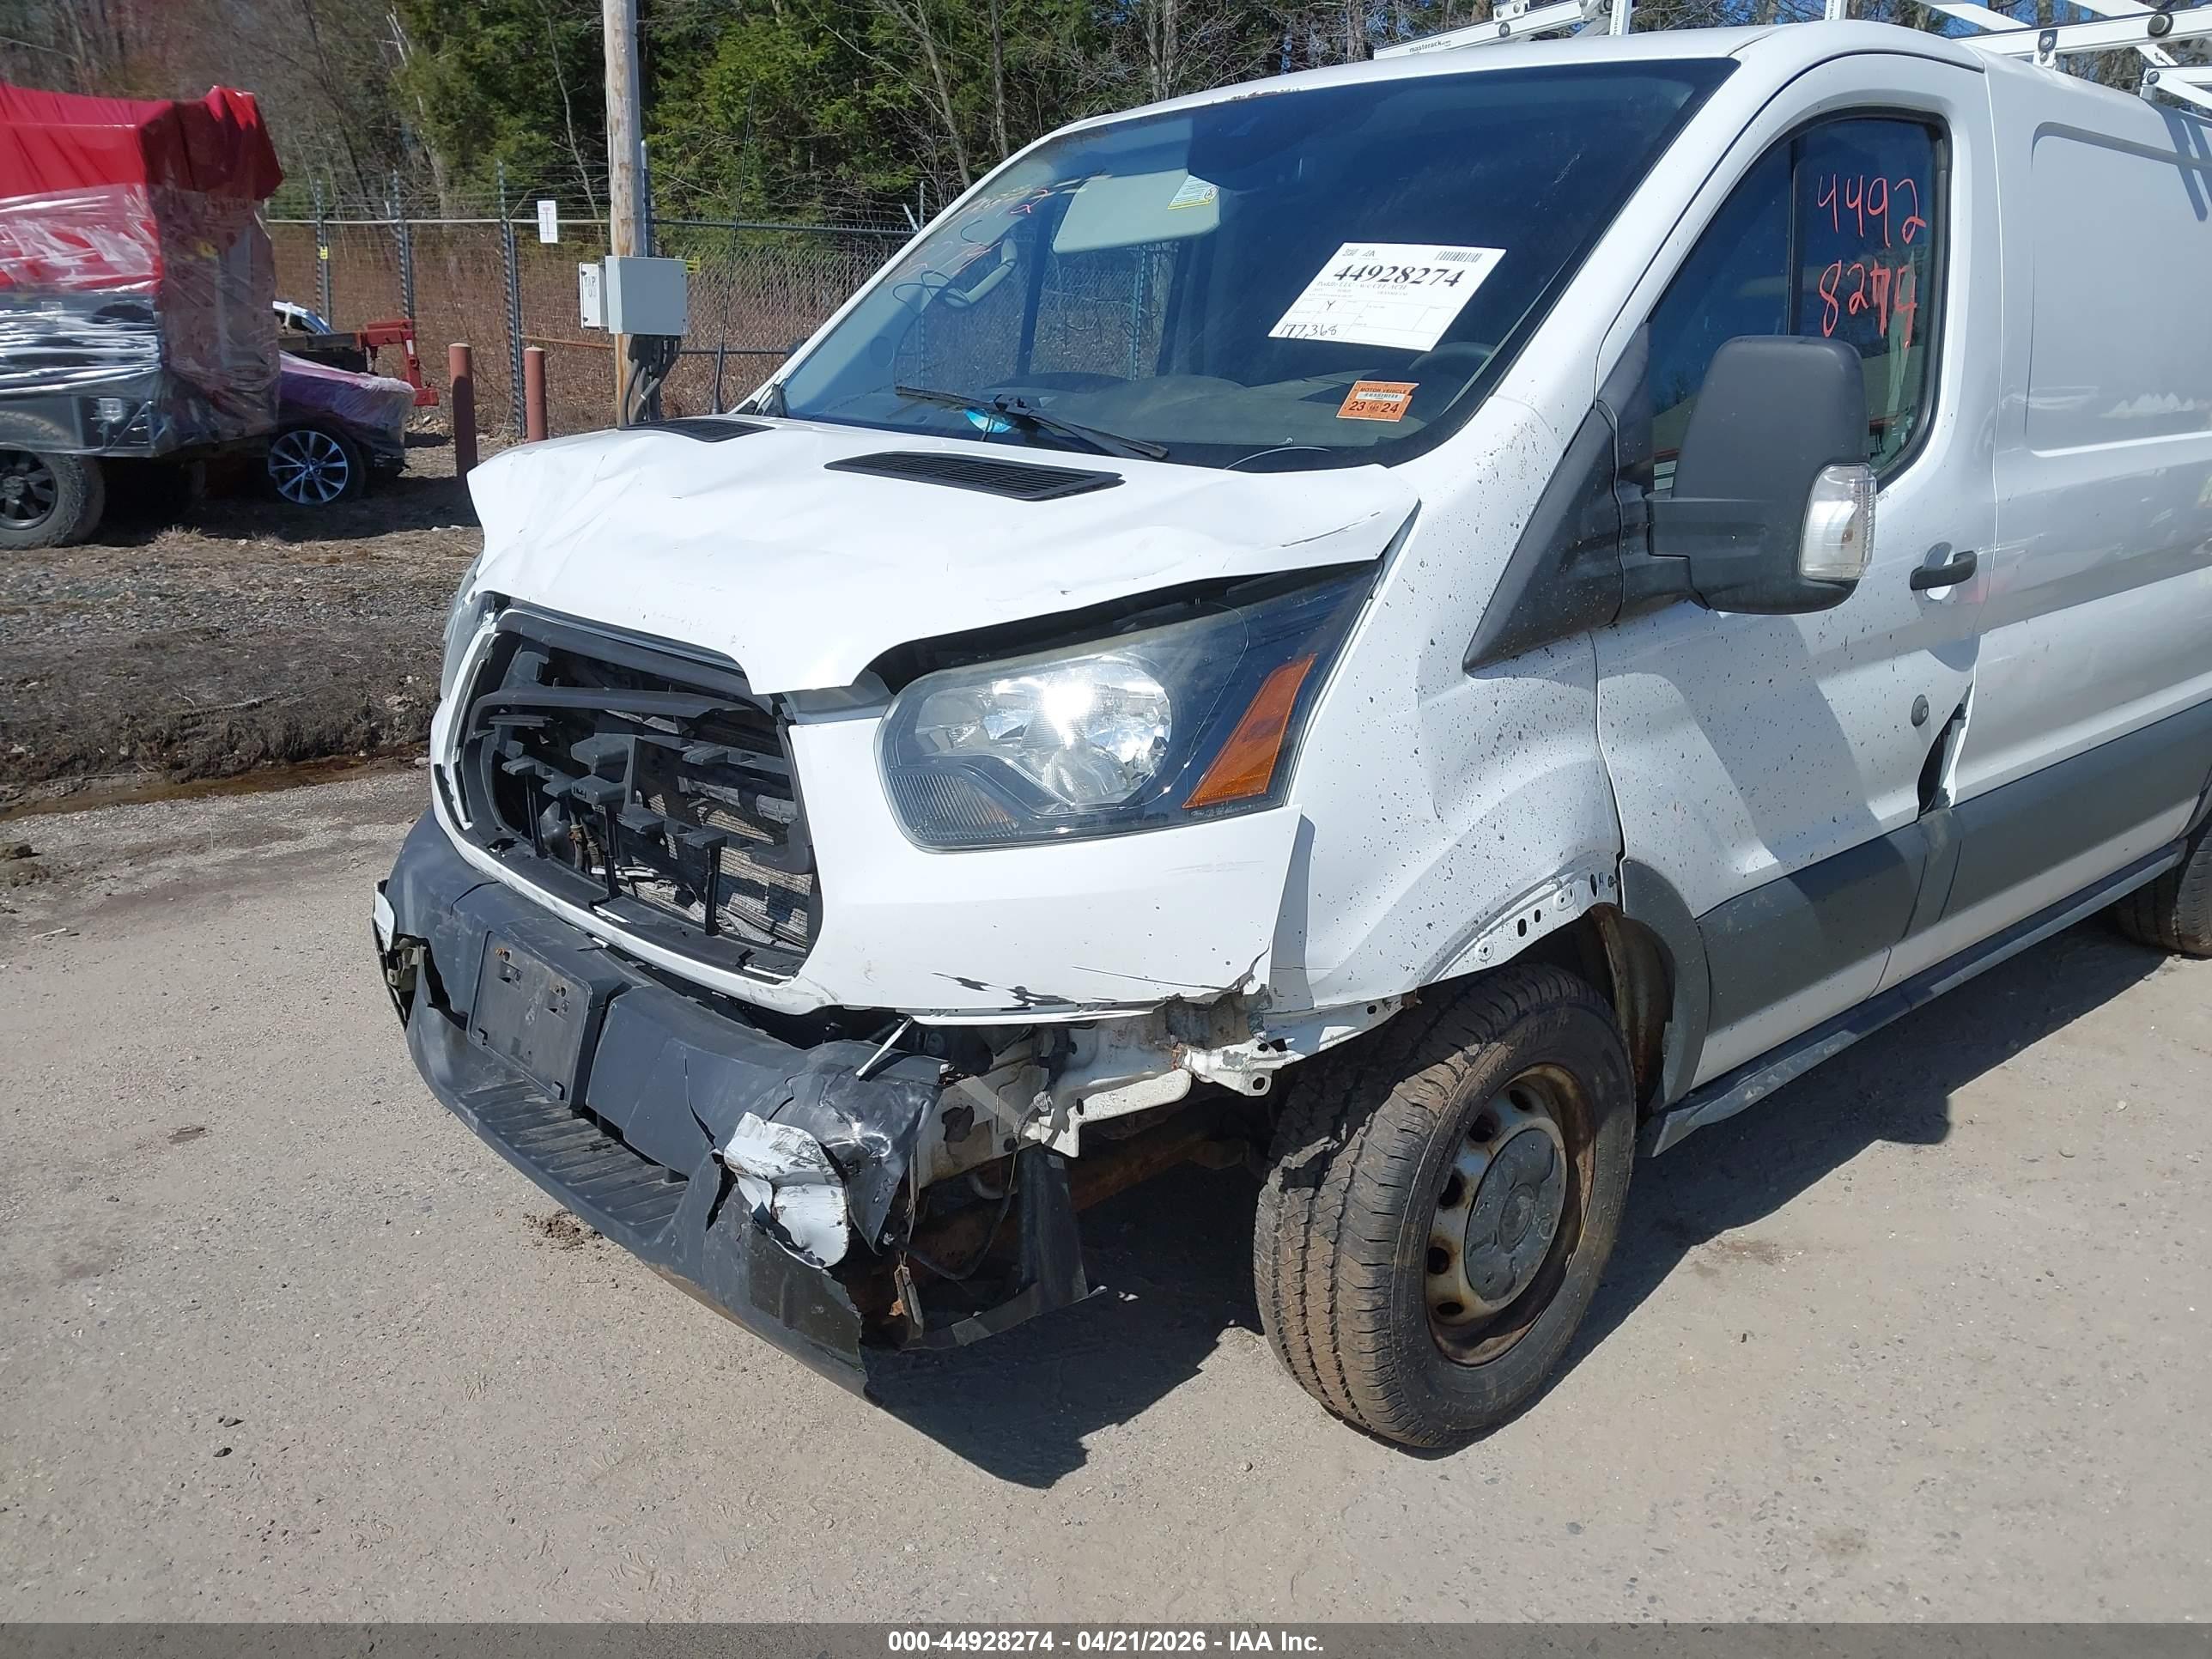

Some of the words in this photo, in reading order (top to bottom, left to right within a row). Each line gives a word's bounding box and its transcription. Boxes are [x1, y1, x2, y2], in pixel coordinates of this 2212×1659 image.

[1817, 173, 1926, 247] 4492
[1334, 264, 1466, 288] 44928274
[1348, 400, 1366, 411] 23
[1381, 403, 1399, 413] 24
